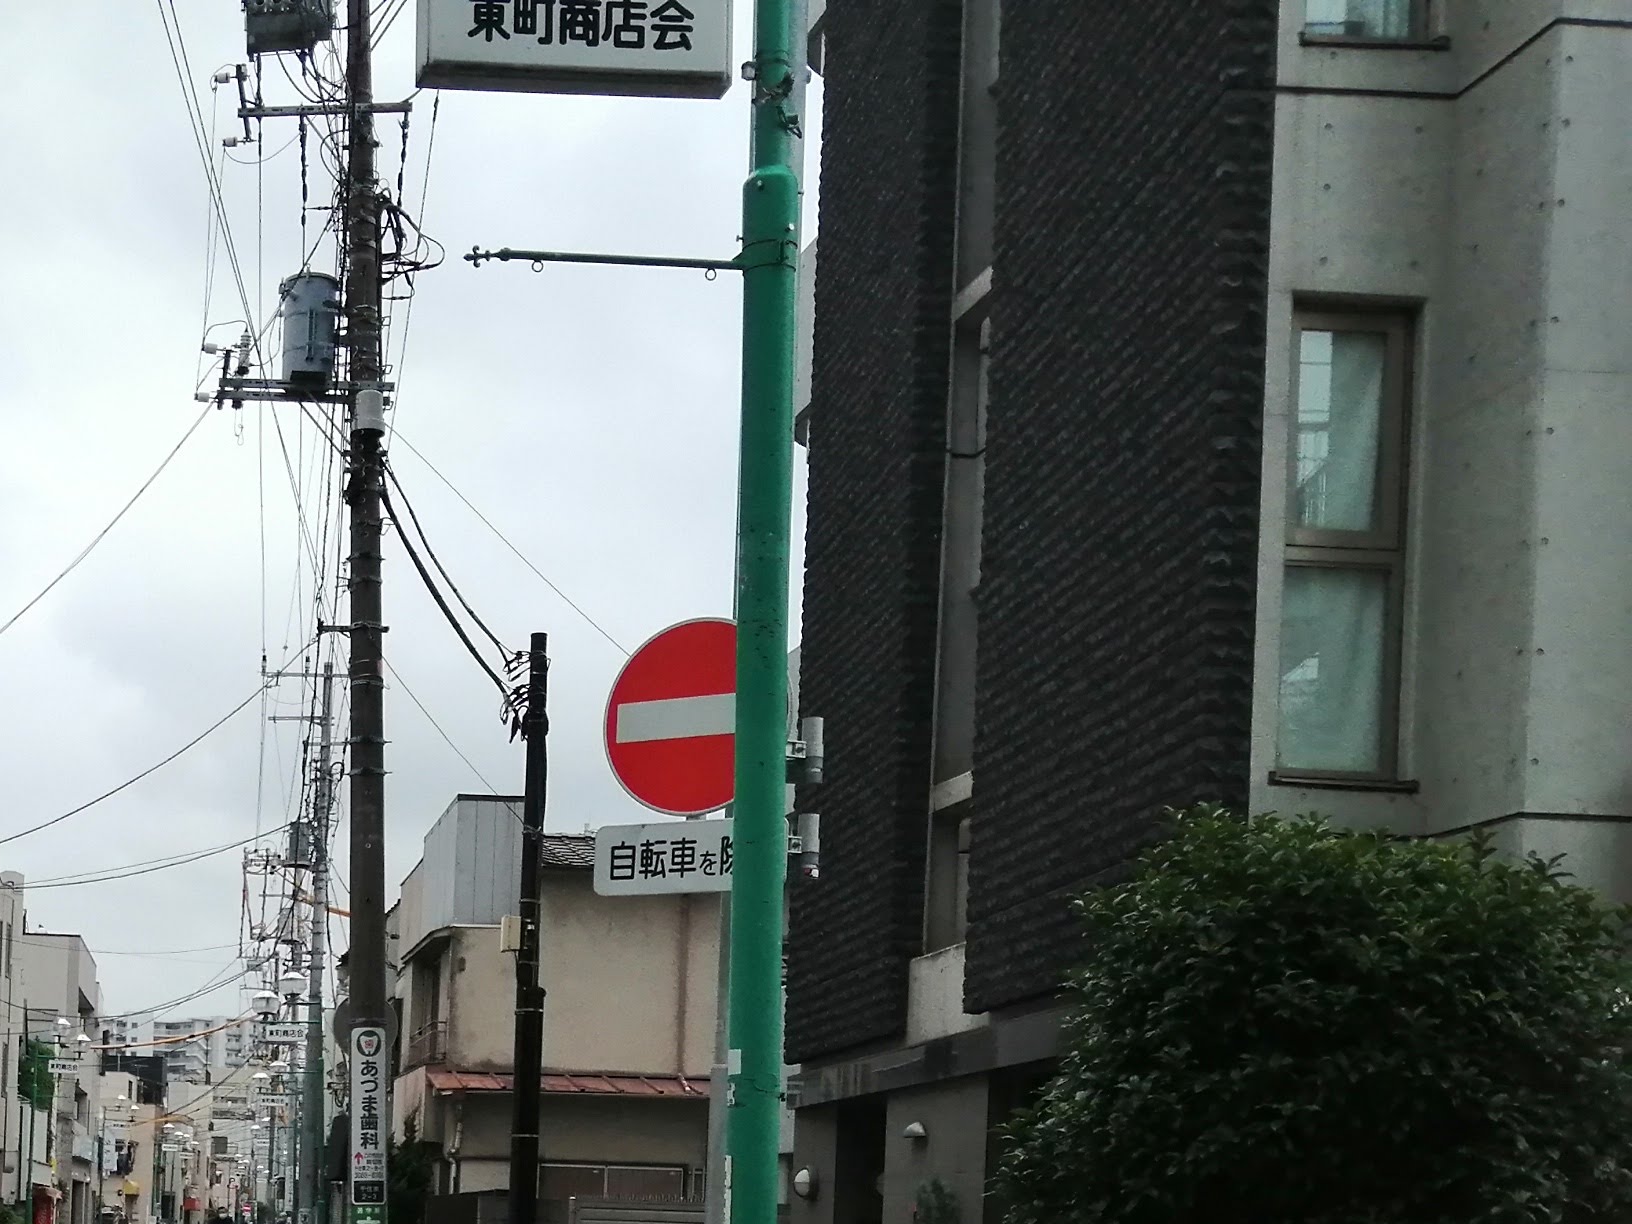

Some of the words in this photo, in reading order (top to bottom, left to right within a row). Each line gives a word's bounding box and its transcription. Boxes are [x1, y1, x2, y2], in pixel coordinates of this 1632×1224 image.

[468, 0, 695, 51] 東町商店会
[360, 1060, 380, 1150] あづま歯科
